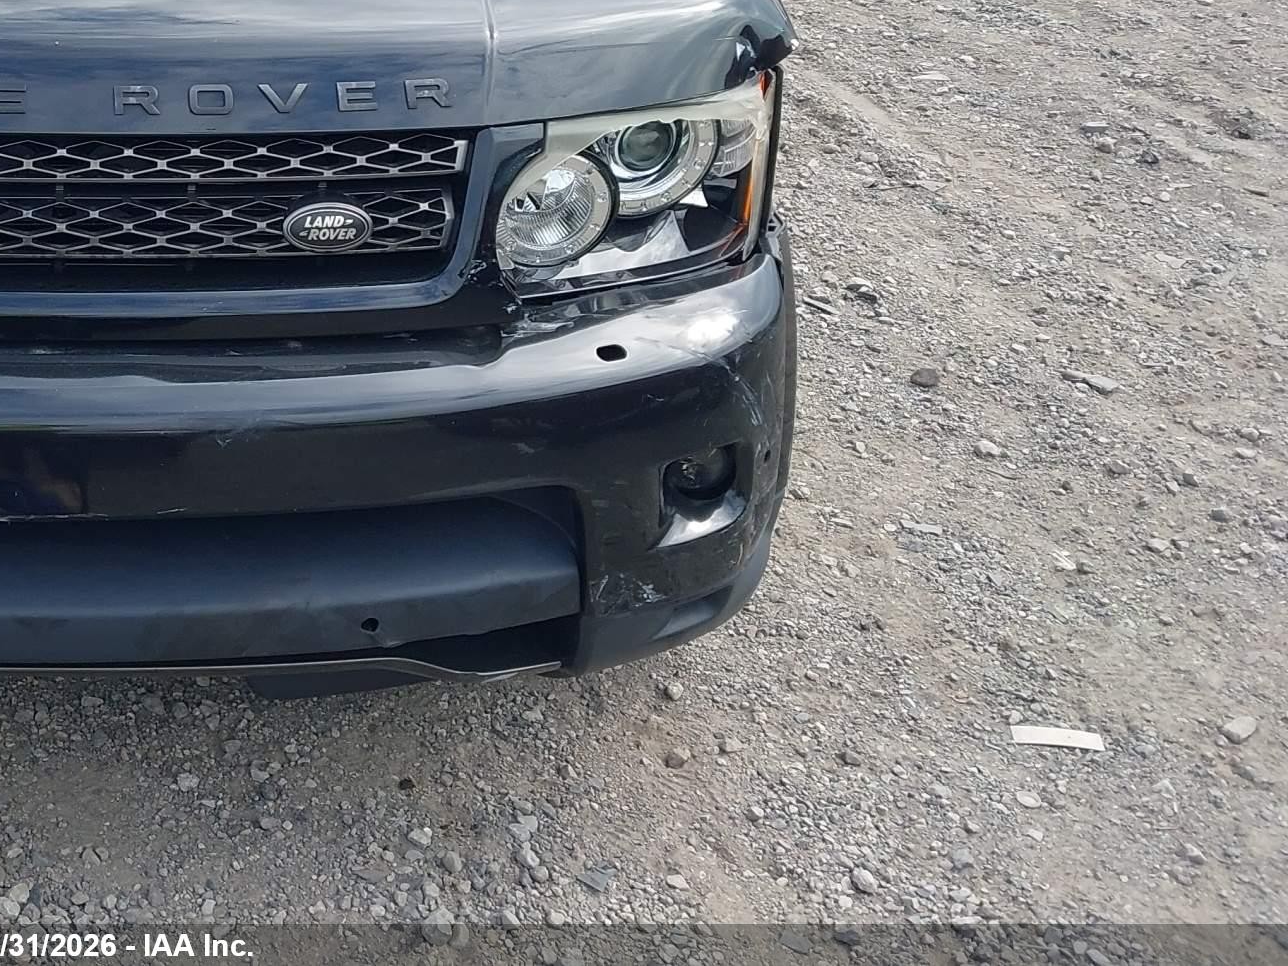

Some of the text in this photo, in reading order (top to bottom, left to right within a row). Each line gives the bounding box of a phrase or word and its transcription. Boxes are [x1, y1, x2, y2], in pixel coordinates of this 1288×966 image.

[112, 77, 453, 116] ROVER
[304, 215, 345, 228] LAND
[307, 227, 357, 241] ROVER
